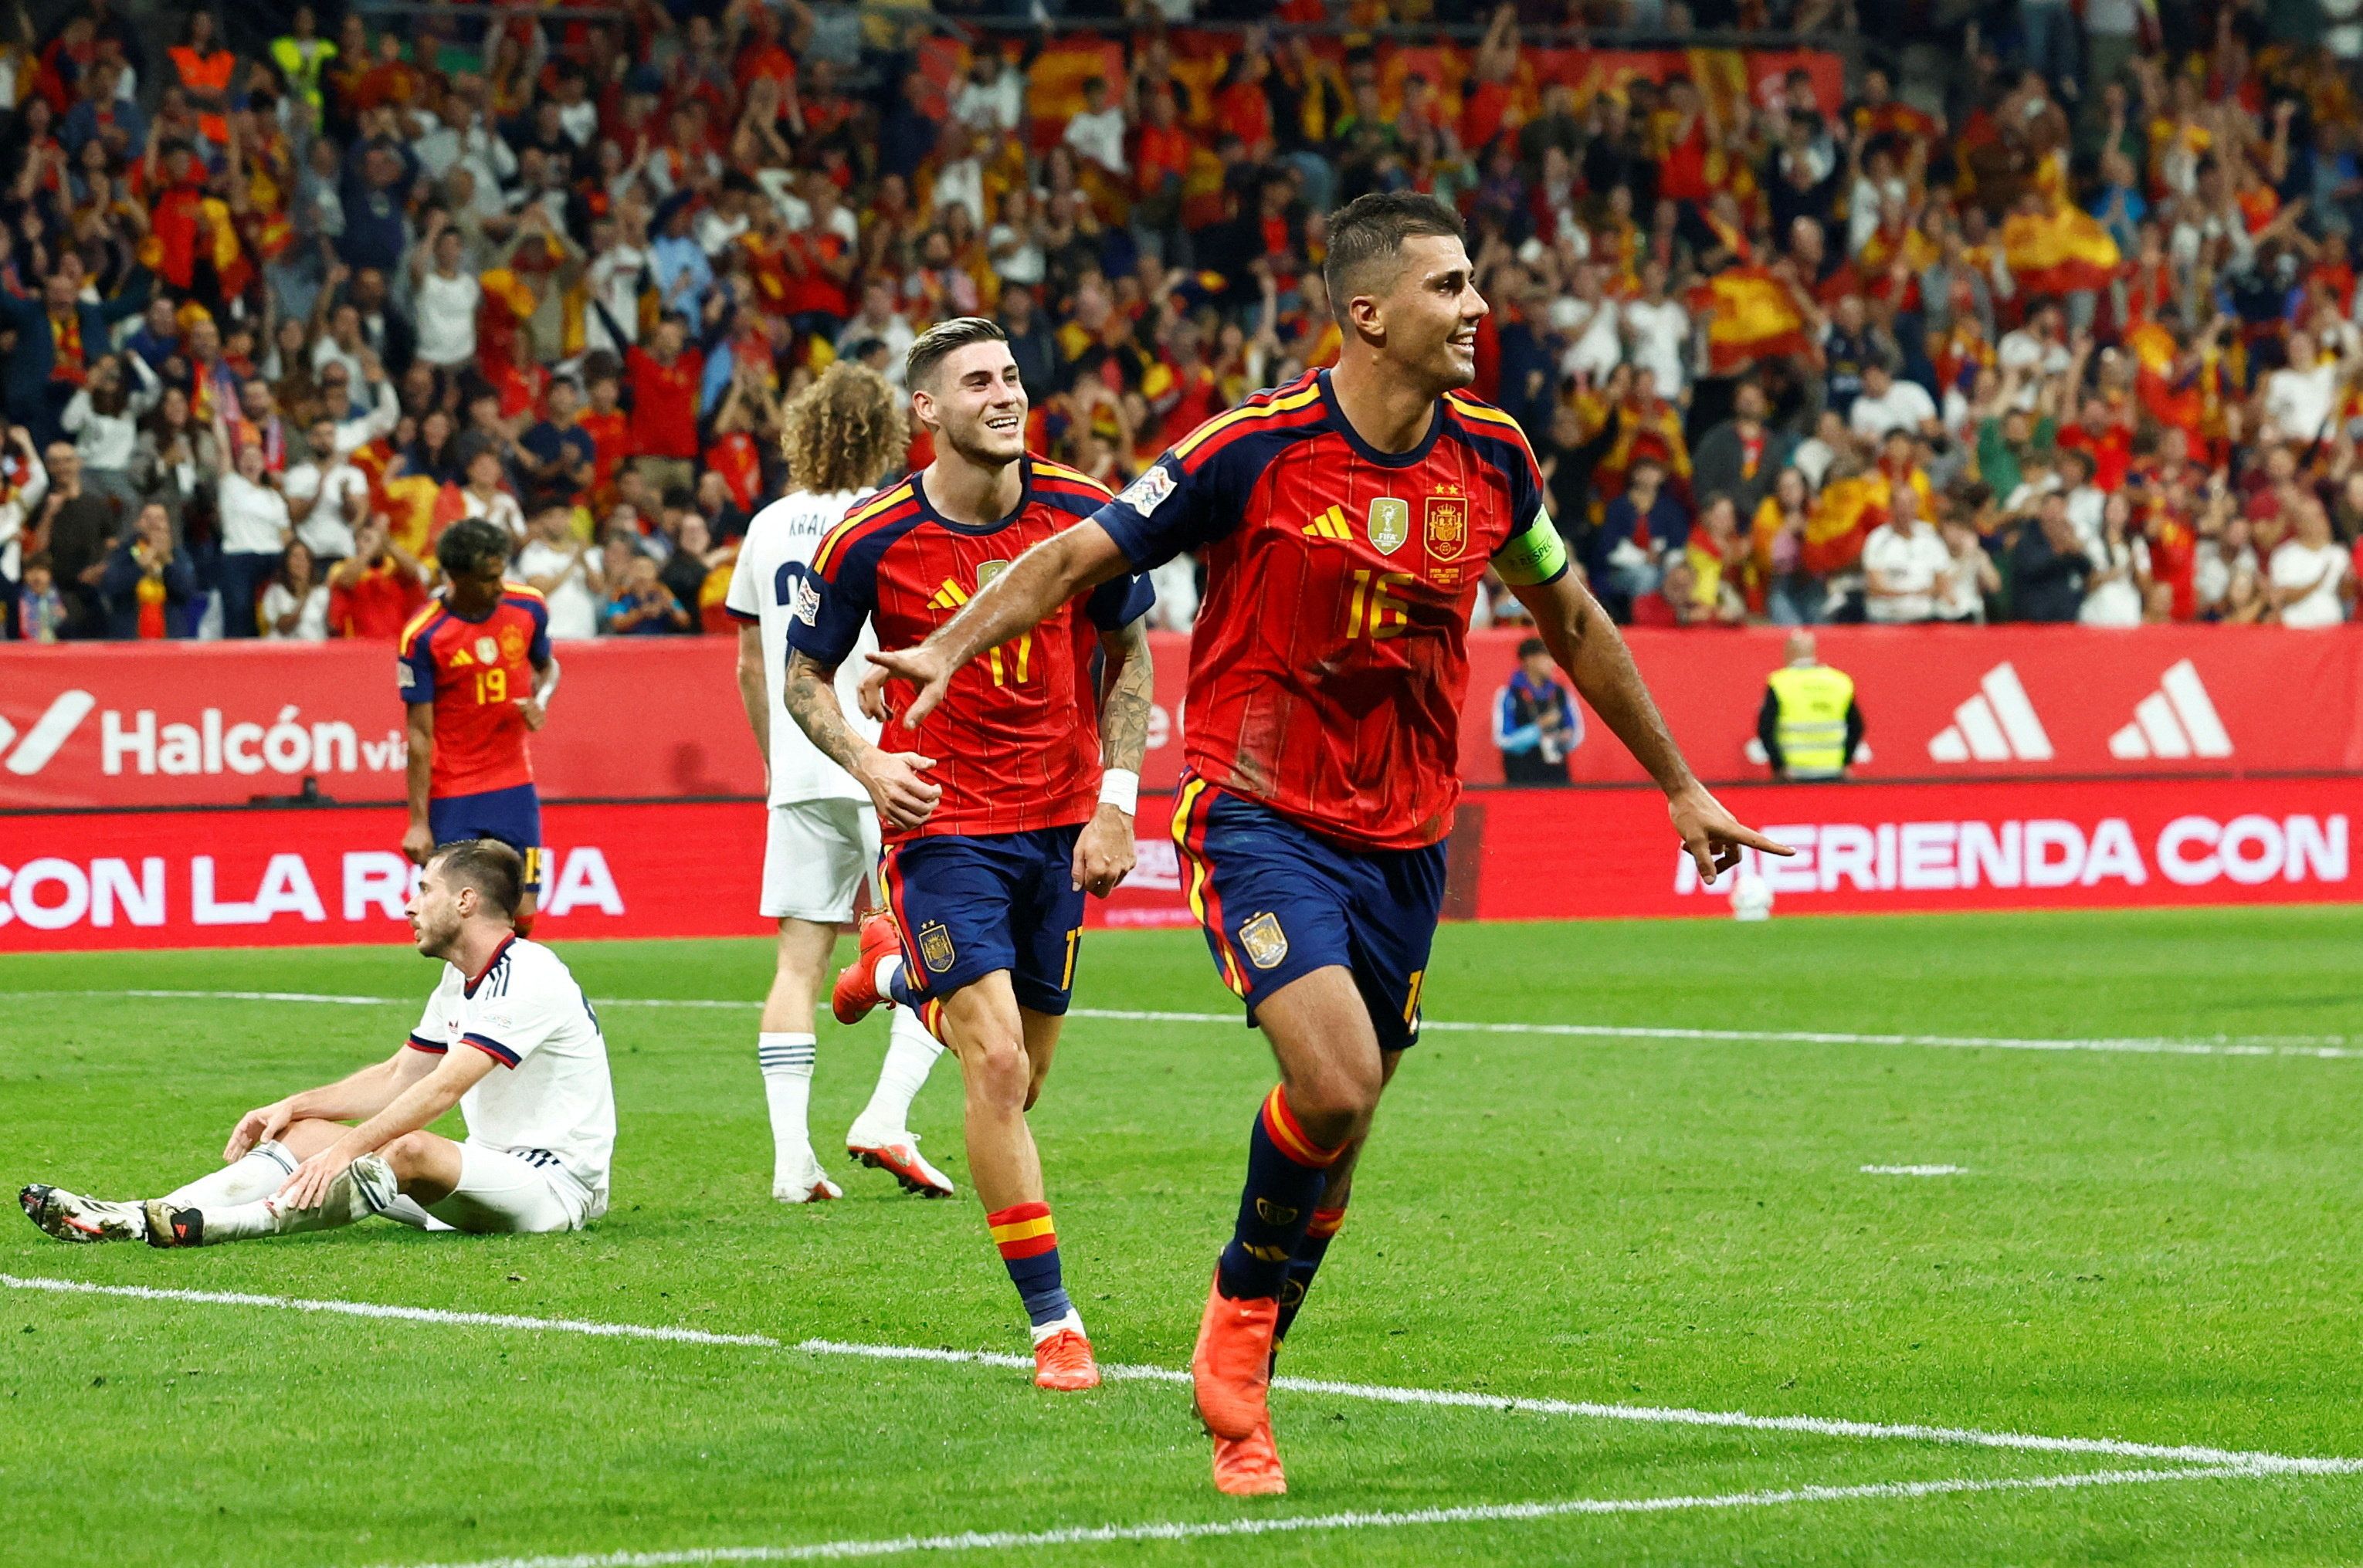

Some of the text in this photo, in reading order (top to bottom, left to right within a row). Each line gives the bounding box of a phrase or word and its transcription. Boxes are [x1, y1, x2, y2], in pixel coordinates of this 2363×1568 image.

[1378, 532, 1396, 540] FIFA
[1346, 569, 1415, 639] 16
[476, 667, 507, 706] 19
[101, 704, 359, 775] Halcón
[2155, 813, 2350, 886] CON
[0, 856, 166, 930] ON
[191, 853, 327, 925] LA
